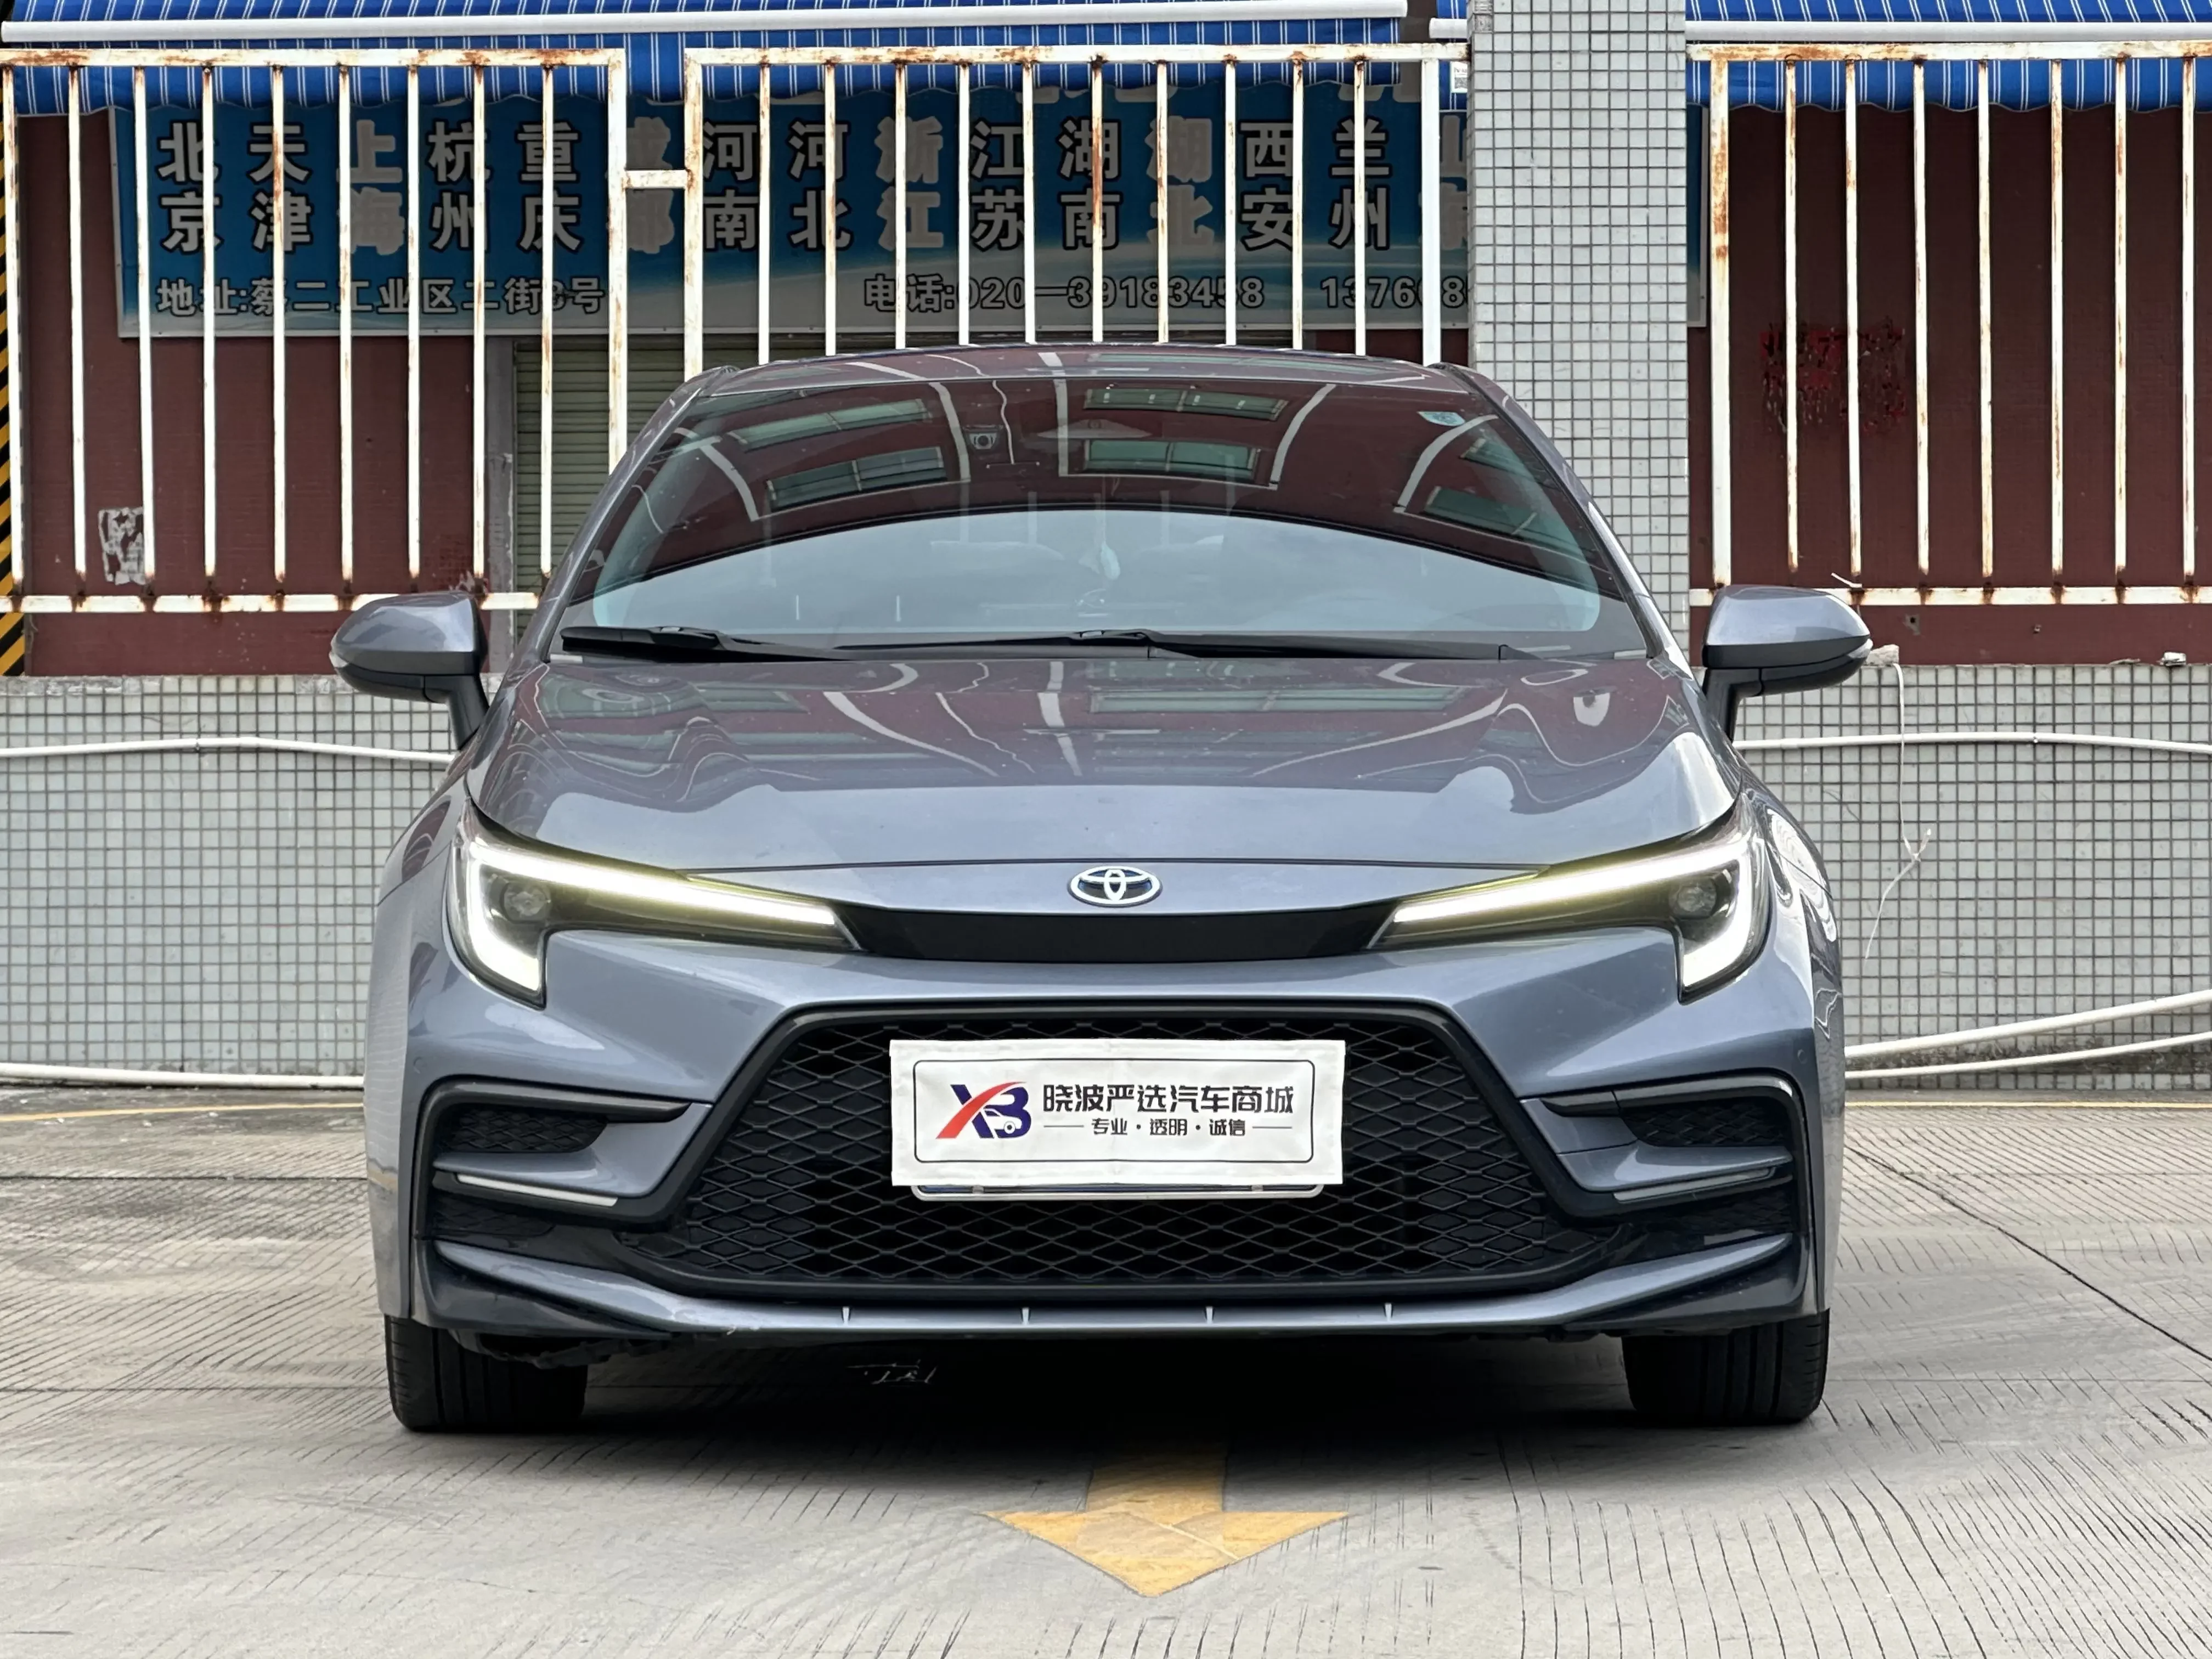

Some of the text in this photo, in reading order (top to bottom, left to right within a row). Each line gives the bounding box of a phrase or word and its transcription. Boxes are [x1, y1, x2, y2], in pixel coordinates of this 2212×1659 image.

[157, 120, 222, 252] 北京
[247, 122, 312, 252] 天津
[427, 120, 490, 252] 杭州
[516, 120, 583, 253] 重庆
[702, 120, 761, 251] 河南
[788, 120, 853, 251] 河北
[874, 116, 943, 252] 浙江
[970, 119, 1026, 251] 江苏
[1057, 117, 1122, 251] 湖南
[1239, 120, 1298, 251] 西安
[1329, 117, 1391, 251] 兰州
[1043, 1084, 1294, 1114] 晓波严选汽车商城
